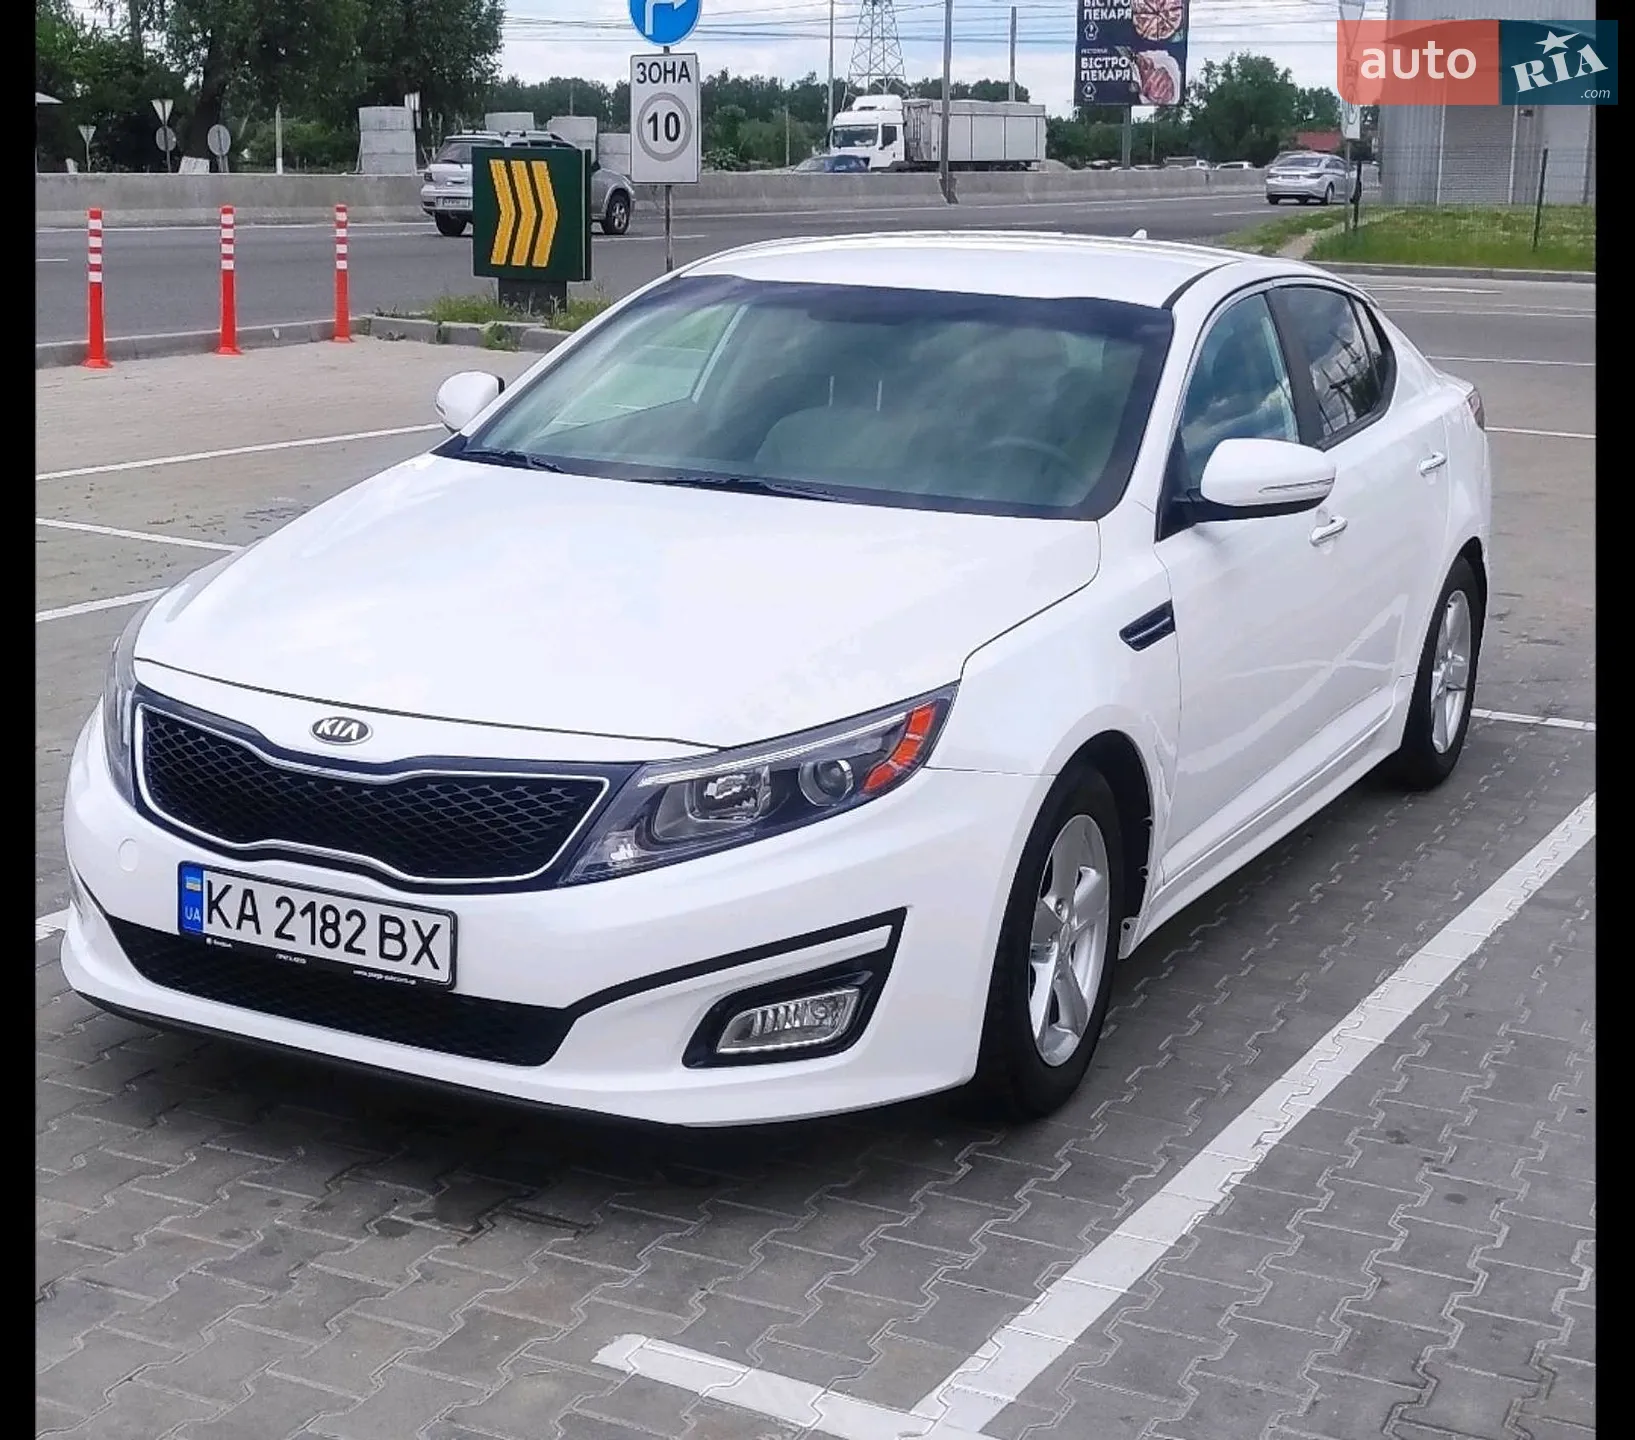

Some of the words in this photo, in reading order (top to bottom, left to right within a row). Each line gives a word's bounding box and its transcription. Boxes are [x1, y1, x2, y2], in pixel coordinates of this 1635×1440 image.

[1083, 8, 1132, 20] ПЕКАРЯ
[636, 60, 691, 84] ЗОНА
[1080, 56, 1130, 69] БІСТРО
[1080, 69, 1131, 81] ПЕКАРЯ
[647, 111, 681, 143] 10
[316, 719, 360, 740] KIA
[185, 905, 201, 922] UA
[206, 880, 262, 935] KA
[274, 896, 367, 956] 2182
[378, 913, 442, 970] BX
